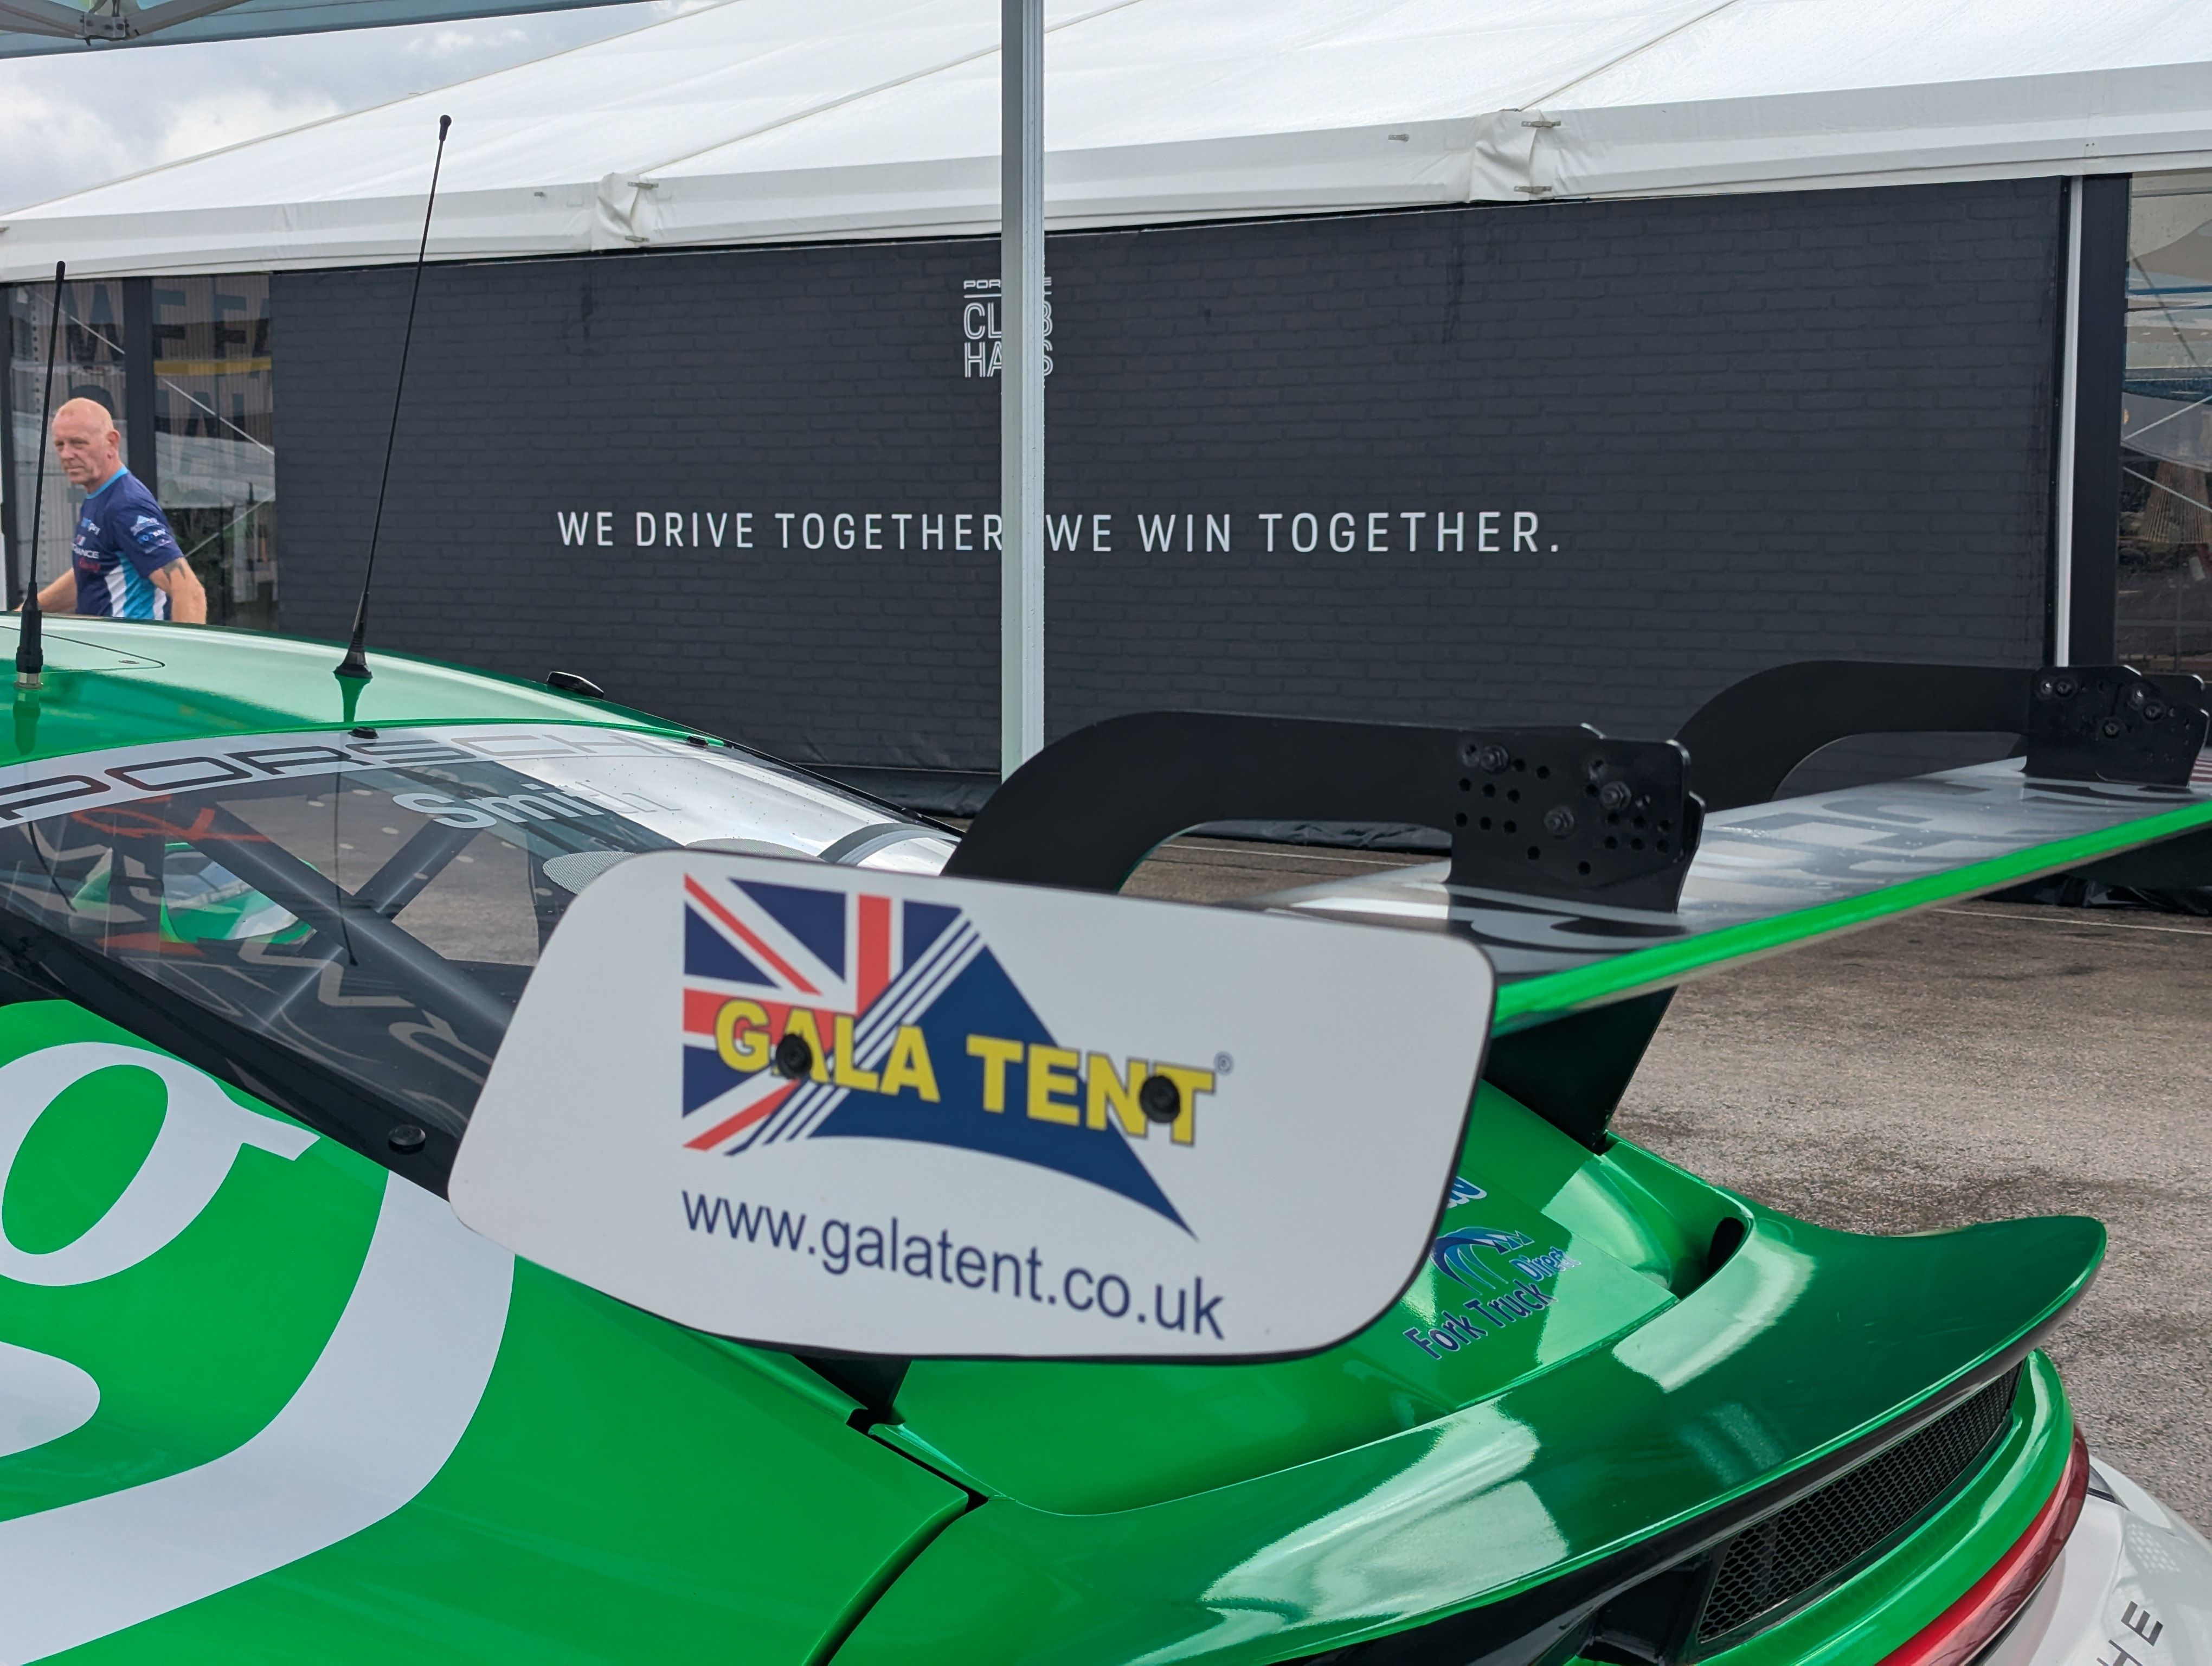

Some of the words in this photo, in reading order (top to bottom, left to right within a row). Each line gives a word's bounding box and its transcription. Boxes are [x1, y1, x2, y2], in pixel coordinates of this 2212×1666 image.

[963, 277, 1052, 290] PORE
[557, 511, 613, 546] WE
[636, 511, 753, 548] DRIVE
[774, 512, 1002, 550] TOGETHER
[1045, 514, 1112, 552] WE
[1137, 514, 1230, 553] WIN
[1258, 511, 1559, 553] TOGETHER.
[0, 734, 684, 821] PORSCH
[714, 998, 942, 1104] GALA
[681, 1189, 1225, 1341] www.galatent.co.uk
[1509, 1246, 1582, 1281] Direct
[1403, 1310, 1488, 1360] Fork
[1463, 1279, 1559, 1328] Truck
